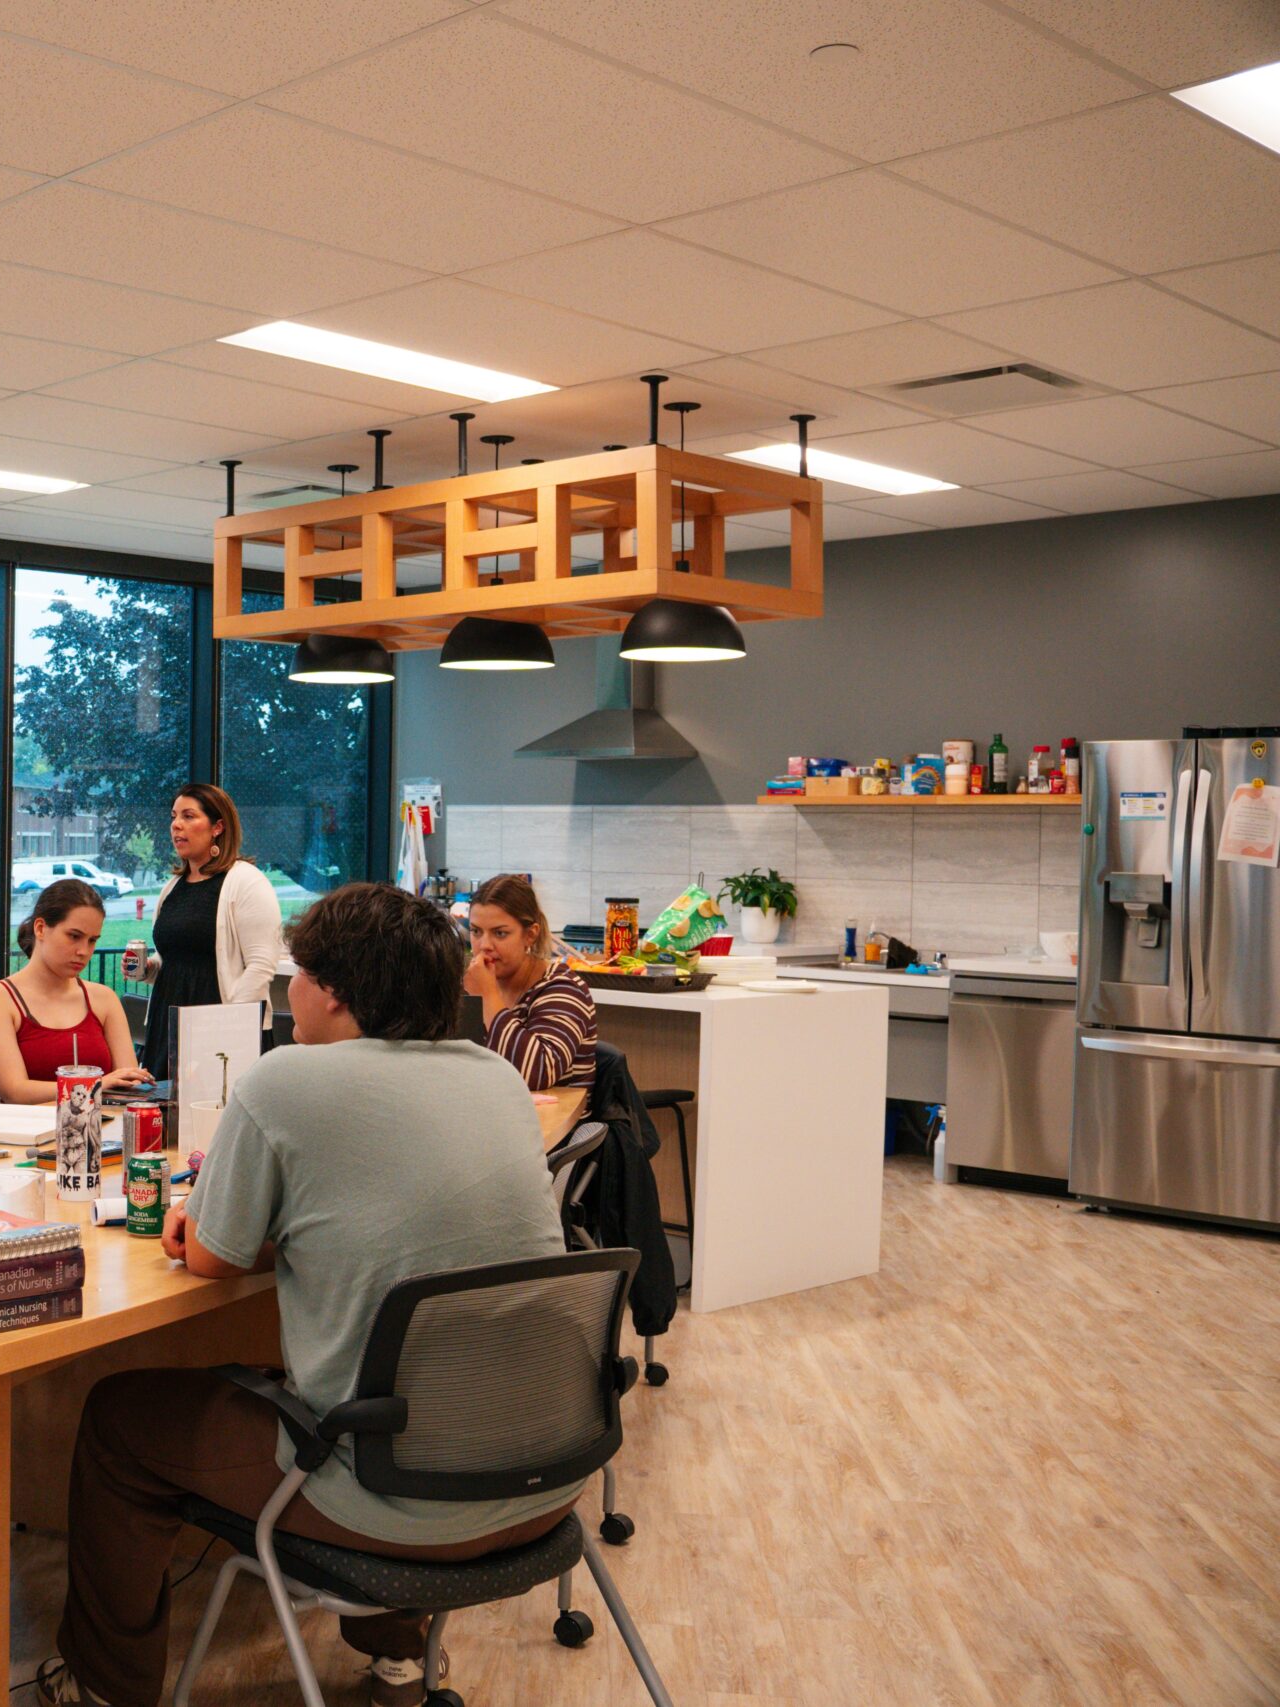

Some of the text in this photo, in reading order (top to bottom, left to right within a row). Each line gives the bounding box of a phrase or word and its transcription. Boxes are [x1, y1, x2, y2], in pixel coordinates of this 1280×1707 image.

[6, 1280, 17, 1293] of
[18, 1276, 53, 1290] Nursing
[18, 1301, 48, 1313] Nursing
[0, 1313, 40, 1328] Techniques
